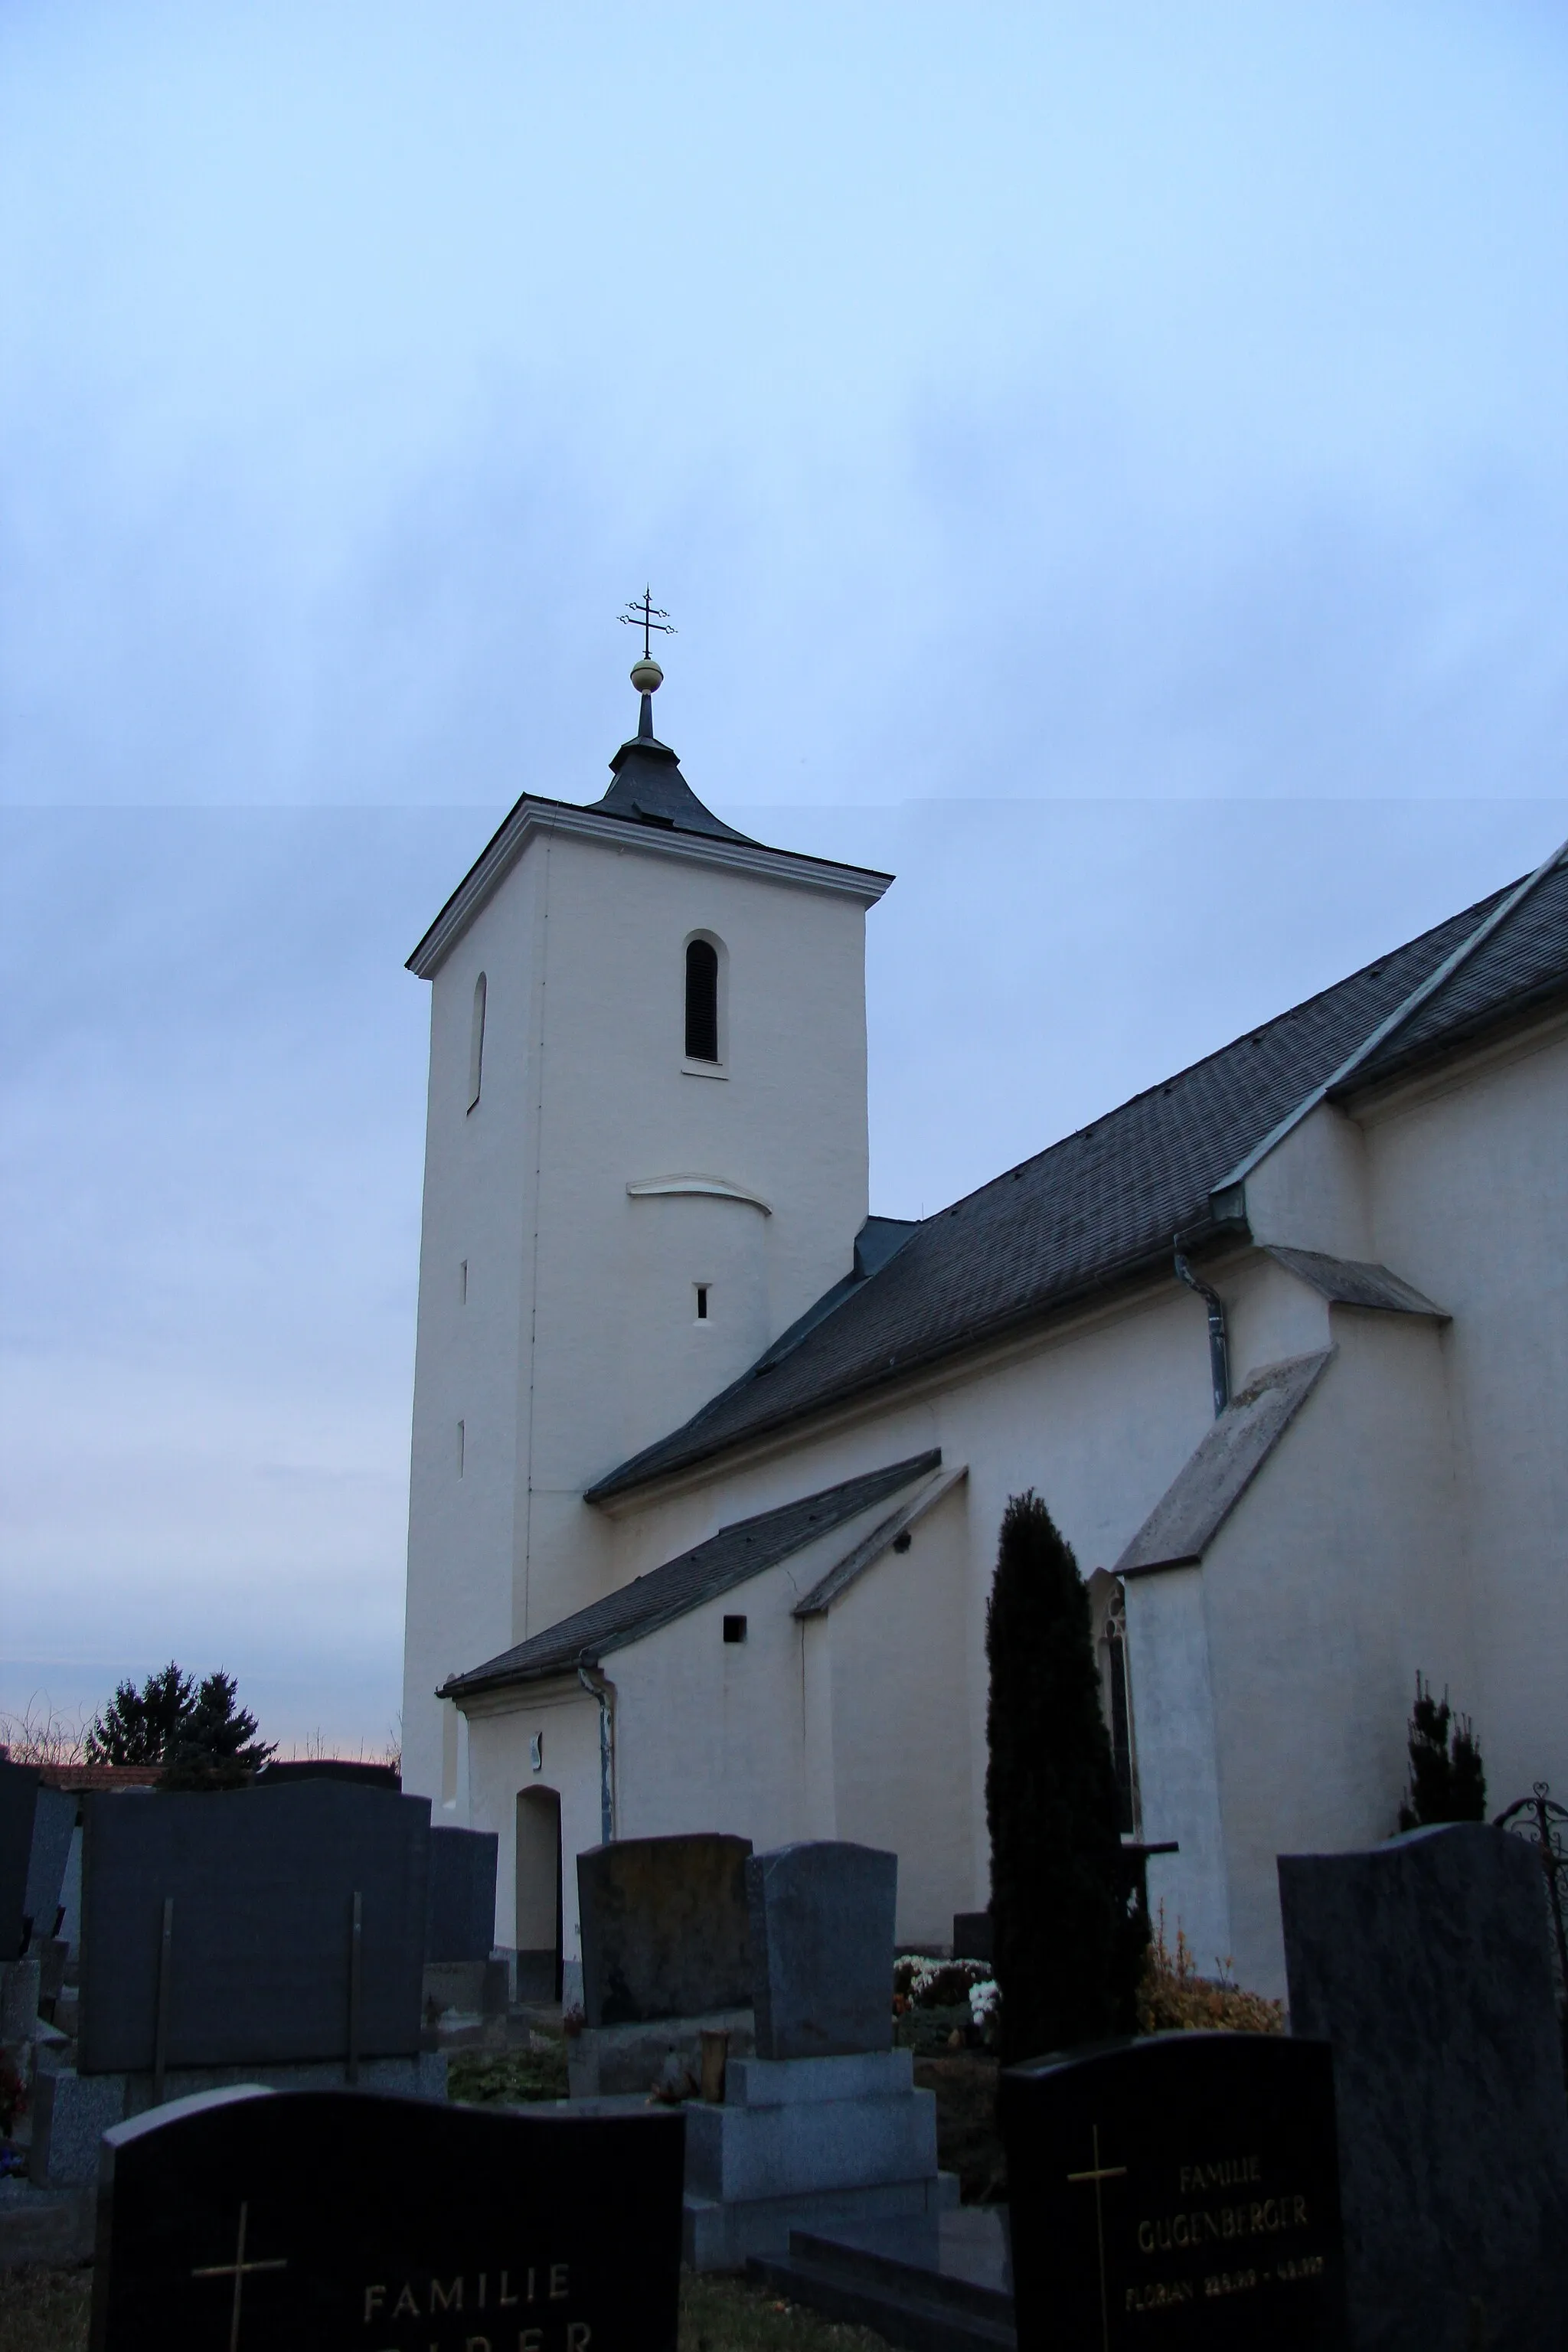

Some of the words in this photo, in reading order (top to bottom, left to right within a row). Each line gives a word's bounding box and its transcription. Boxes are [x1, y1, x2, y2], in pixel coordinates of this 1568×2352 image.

[1179, 2154, 1263, 2196] FAMILIE
[1137, 2194, 1309, 2256] GUGENBERGER
[363, 2262, 570, 2327] FAMILIE
